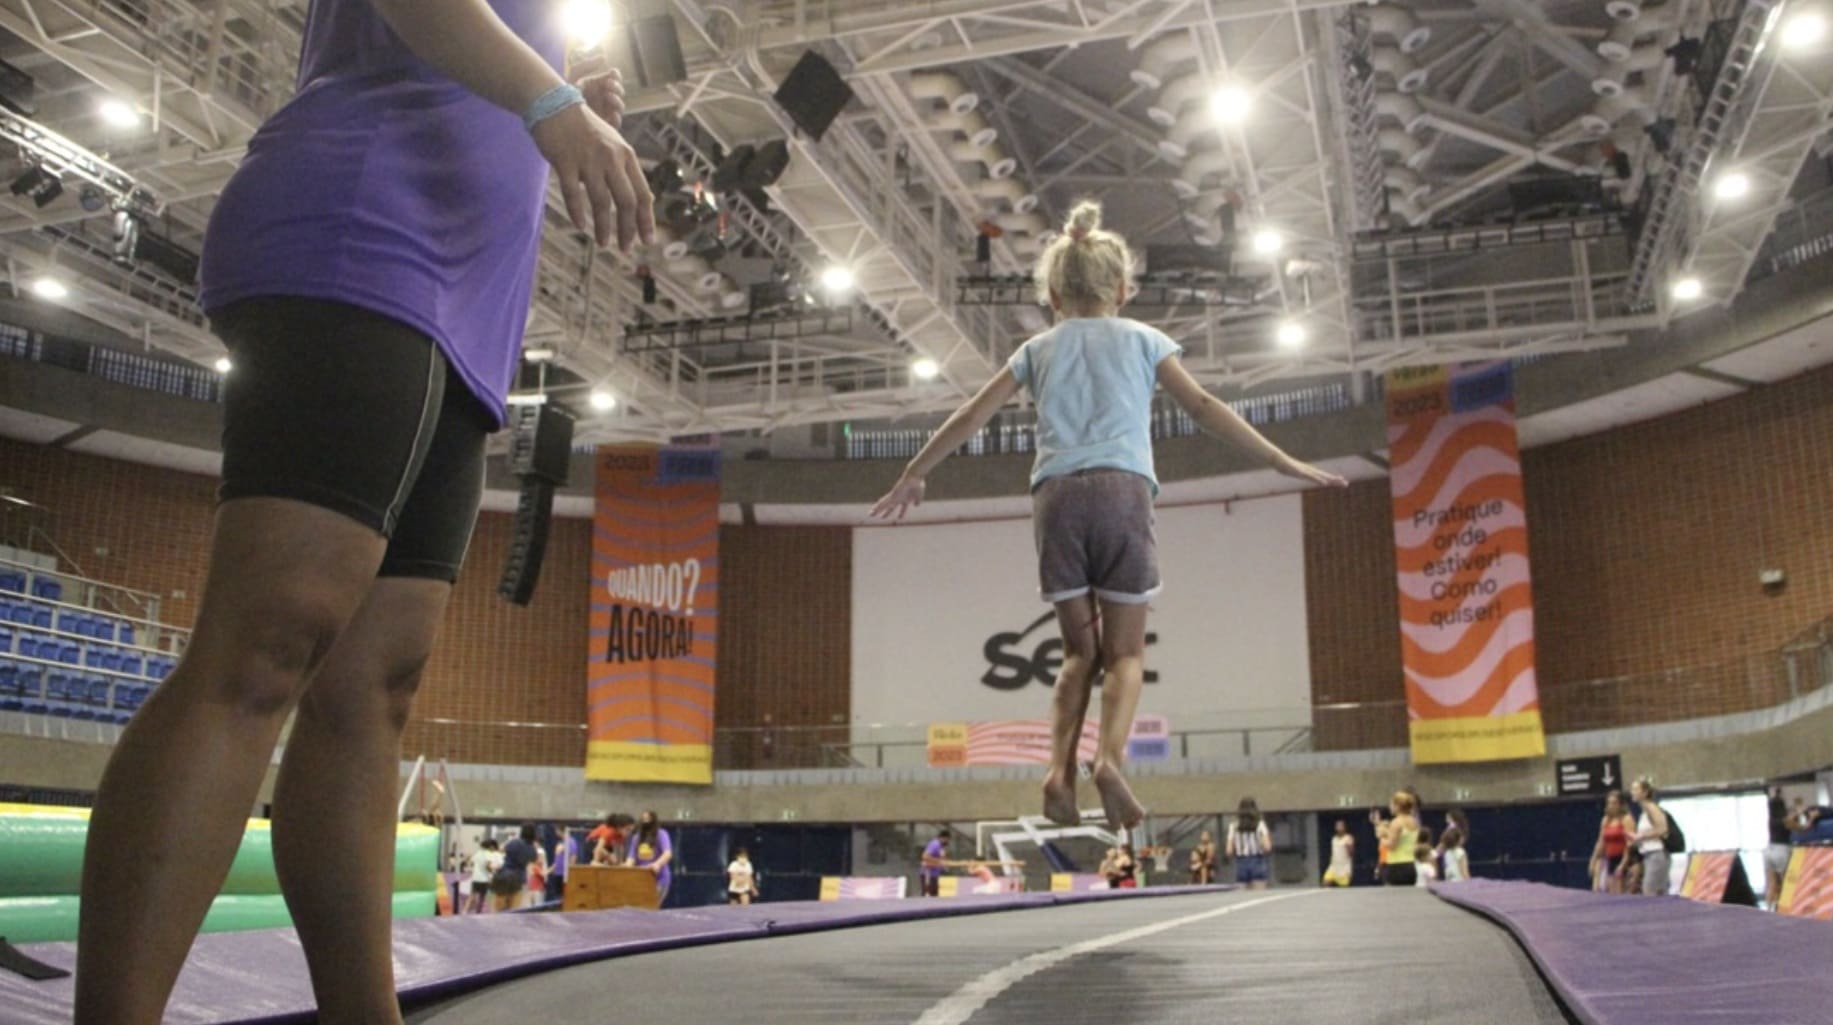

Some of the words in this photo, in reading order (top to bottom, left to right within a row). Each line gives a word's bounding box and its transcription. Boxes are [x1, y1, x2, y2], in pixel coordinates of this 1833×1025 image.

[1414, 500, 1503, 529] Pratique
[1433, 526, 1487, 550] onde
[1423, 547, 1500, 577] estiver!
[607, 558, 700, 616] QUANDO?
[1430, 578, 1497, 601] Como
[1429, 601, 1502, 630] quiser!
[606, 603, 694, 664] AGORA!
